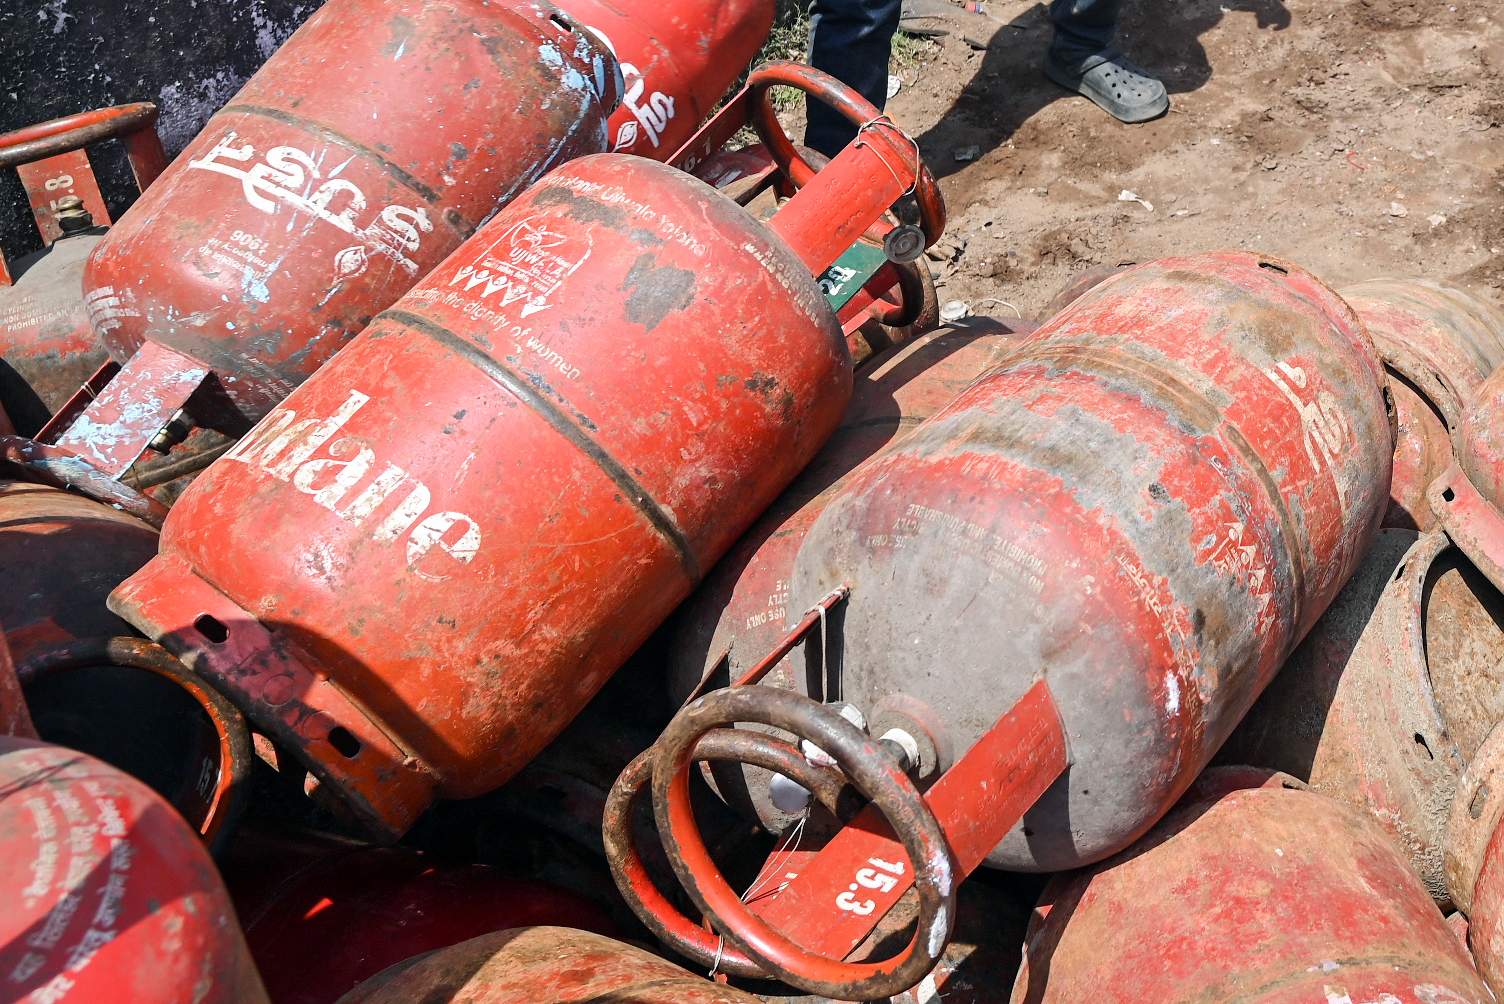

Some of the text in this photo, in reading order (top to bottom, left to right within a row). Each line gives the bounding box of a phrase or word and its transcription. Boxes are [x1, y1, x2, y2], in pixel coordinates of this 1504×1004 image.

[231, 389, 483, 580] ndane
[746, 607, 785, 630] USE ONLY
[831, 855, 907, 919] 15.3
